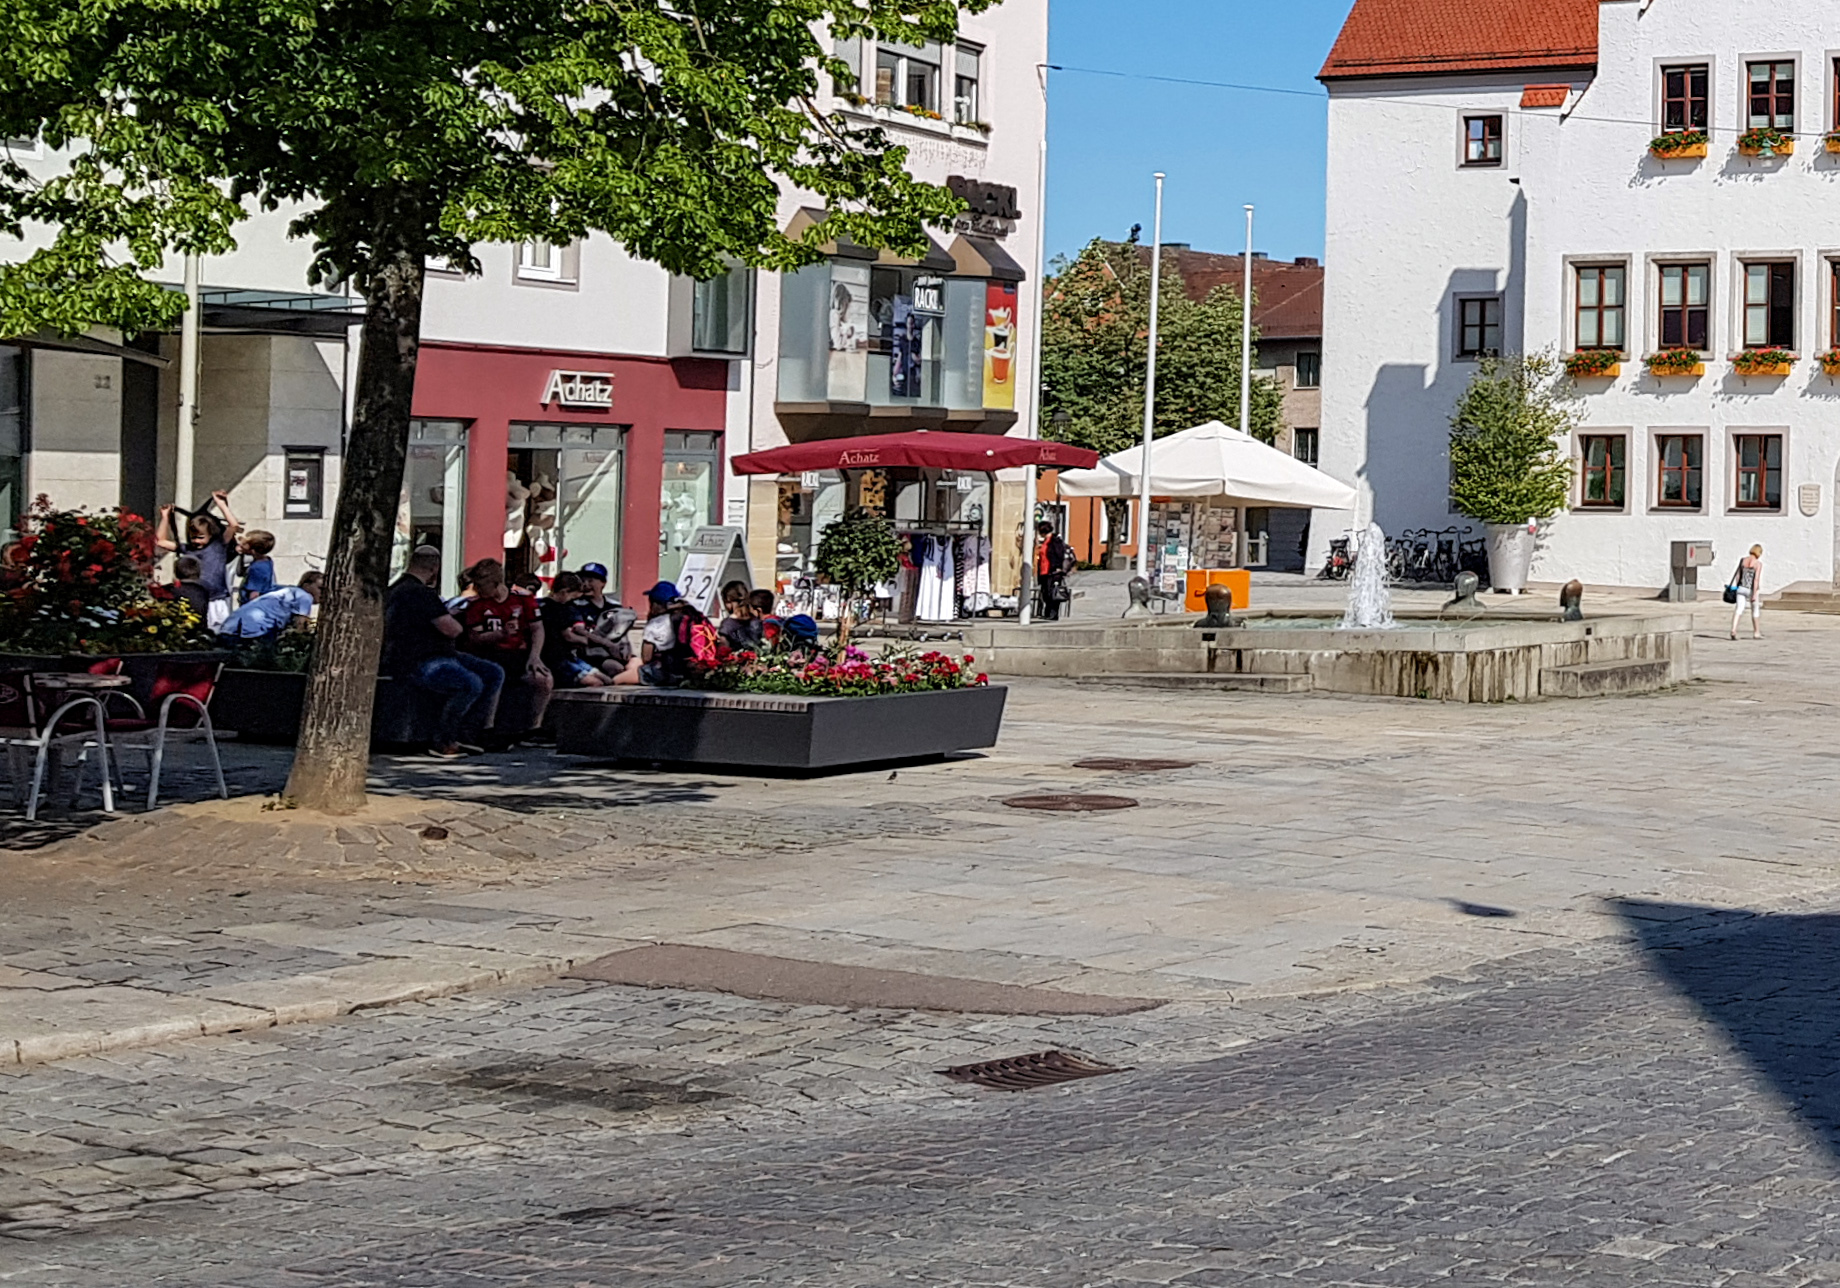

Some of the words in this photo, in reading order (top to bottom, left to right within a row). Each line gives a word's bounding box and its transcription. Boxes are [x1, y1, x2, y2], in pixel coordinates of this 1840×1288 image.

[540, 369, 615, 407] Achatz
[838, 449, 880, 465] Achatz
[696, 575, 713, 600] 2
